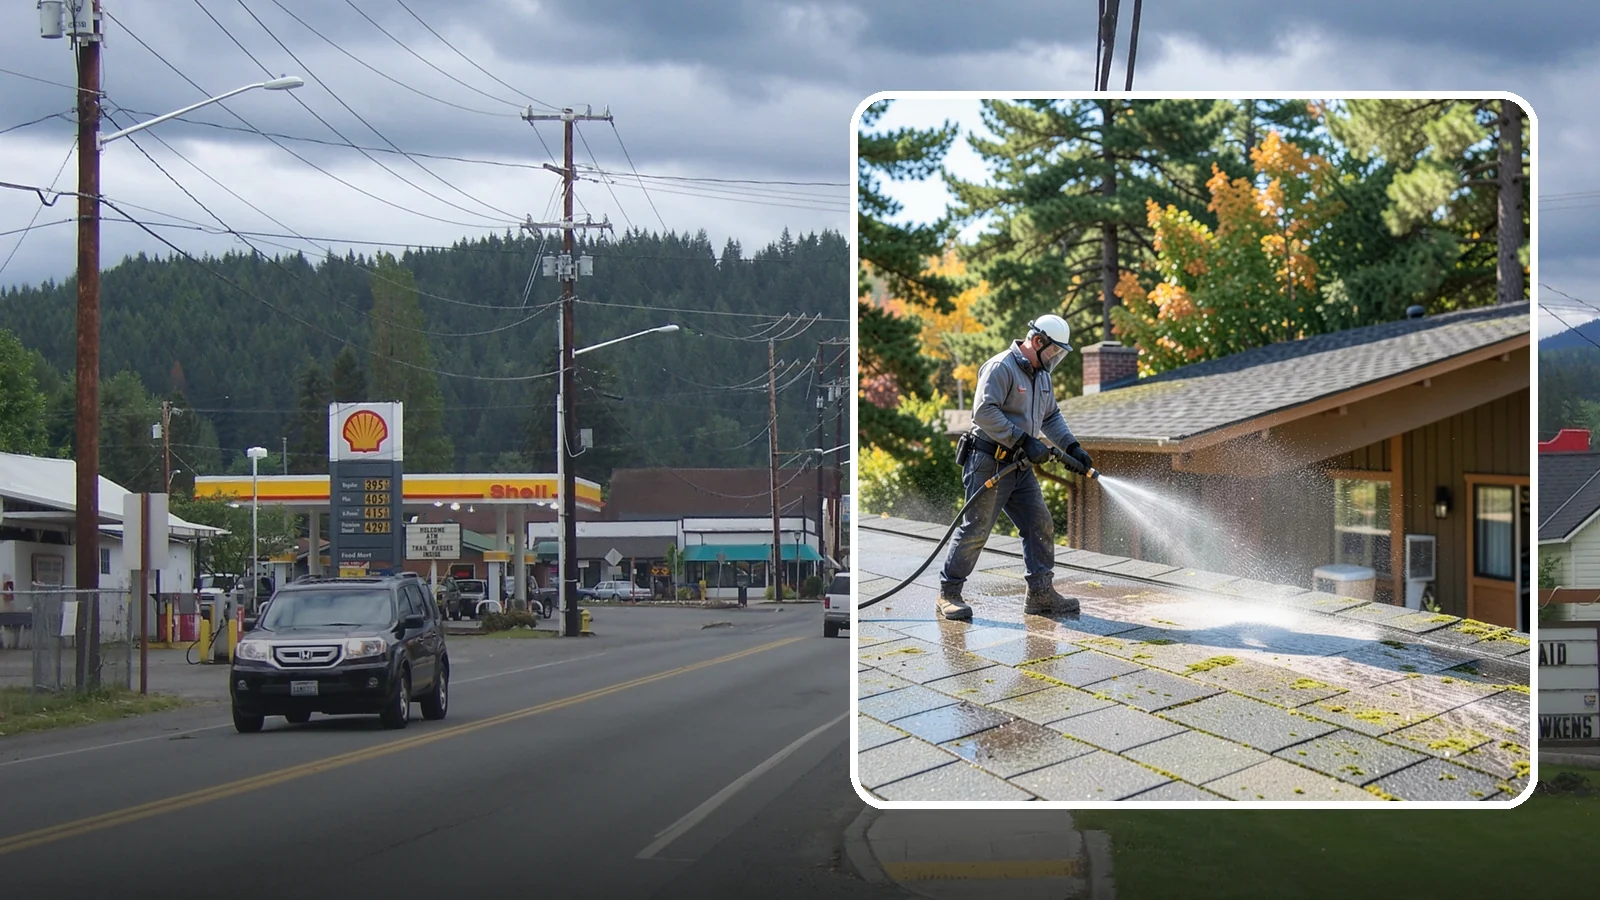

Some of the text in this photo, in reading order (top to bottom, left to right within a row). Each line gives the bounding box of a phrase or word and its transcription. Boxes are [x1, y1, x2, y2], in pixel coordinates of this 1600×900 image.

[365, 480, 384, 490] 395
[490, 484, 547, 499] Shell
[365, 494, 384, 504] 405
[365, 508, 384, 518] 415
[365, 522, 384, 533] 429
